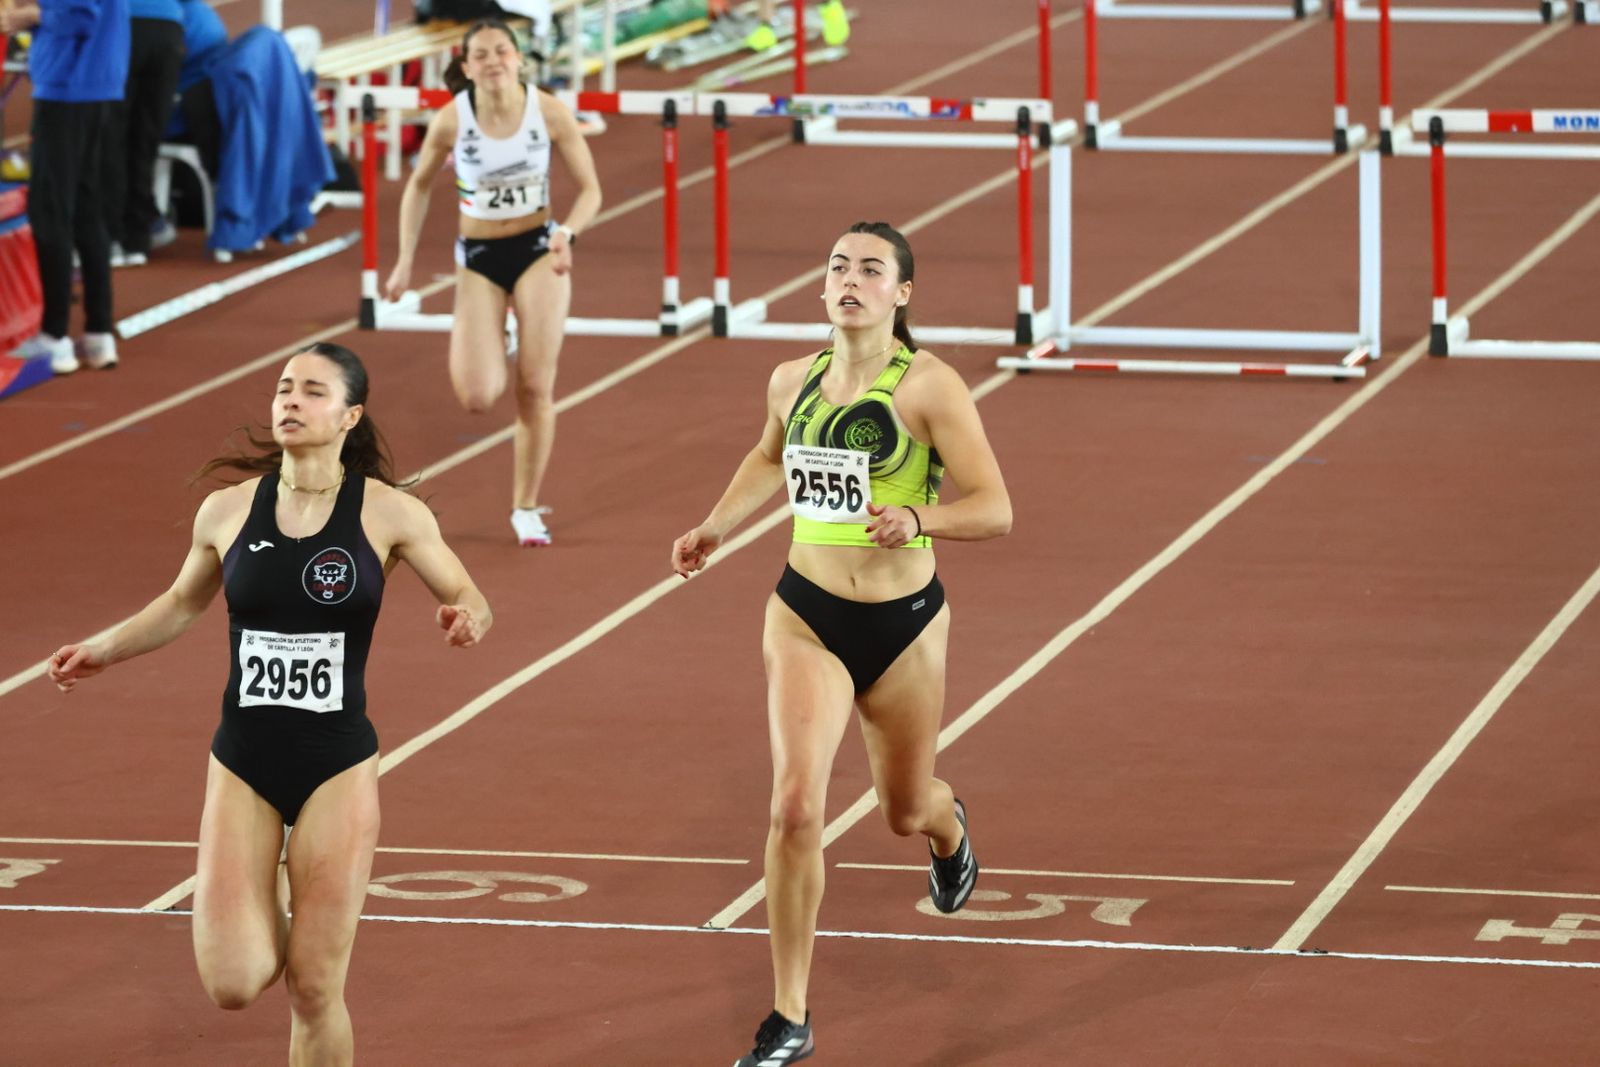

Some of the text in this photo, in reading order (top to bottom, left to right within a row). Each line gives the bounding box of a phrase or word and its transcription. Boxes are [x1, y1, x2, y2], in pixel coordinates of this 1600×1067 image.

[488, 186, 527, 209] 241
[791, 468, 863, 513] 2556
[246, 655, 331, 701] 2956
